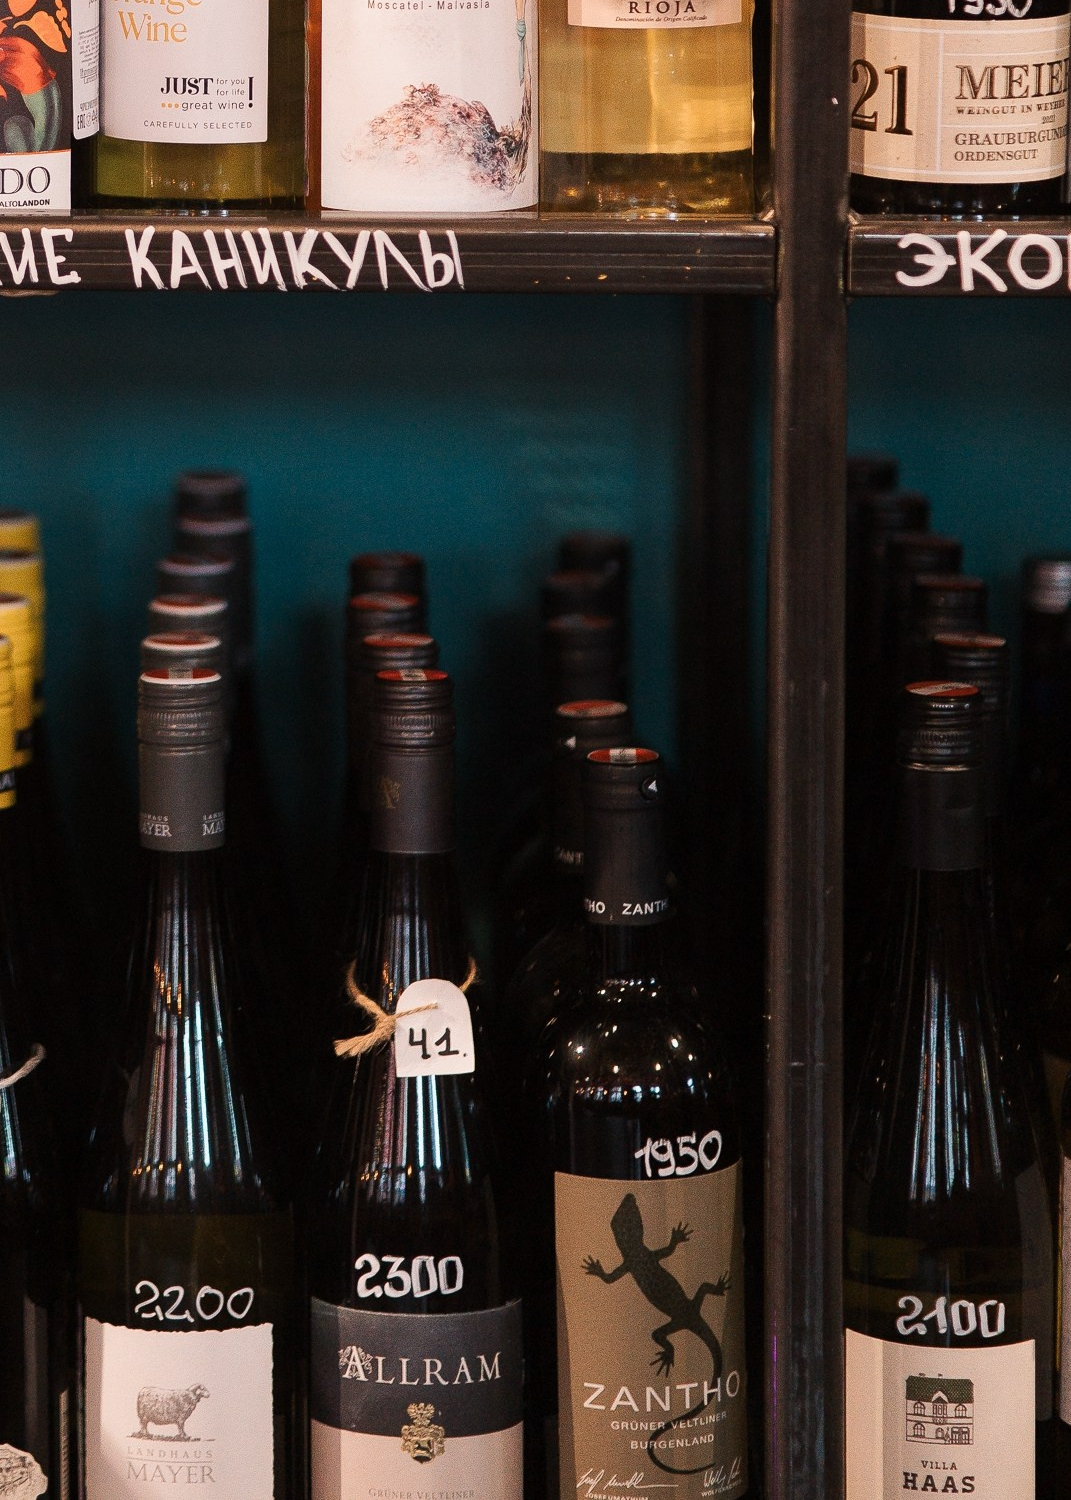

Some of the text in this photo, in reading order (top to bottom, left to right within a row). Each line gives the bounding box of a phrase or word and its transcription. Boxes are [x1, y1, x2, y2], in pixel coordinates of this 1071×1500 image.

[367, 0, 424, 10] Moscatel
[628, 0, 696, 16] RIOJA
[117, 10, 188, 43] Wine
[160, 76, 246, 96] JUST for you
[216, 86, 246, 97] for life
[955, 104, 1033, 115] WEINGUT IN
[143, 119, 254, 130] CAREFULLY SELECTED
[954, 148, 1038, 161] ORDENSGUT
[124, 225, 466, 292] КАНИКУЛЫ
[634, 1129, 723, 1178] 1950
[354, 1252, 464, 1298] 2300
[134, 1279, 254, 1323] 2200
[895, 1295, 1006, 1338] 2100
[339, 1345, 502, 1386] ALLRAM
[582, 1369, 741, 1413] ZANTHO
[610, 1410, 728, 1431] GRÜNER VELTLINER
[630, 1433, 715, 1450] BURGENLAND
[127, 1445, 213, 1460] LANDHAUS
[127, 1461, 216, 1484] MAYER
[920, 1459, 958, 1471] VILLA
[902, 1471, 976, 1494] HAAS
